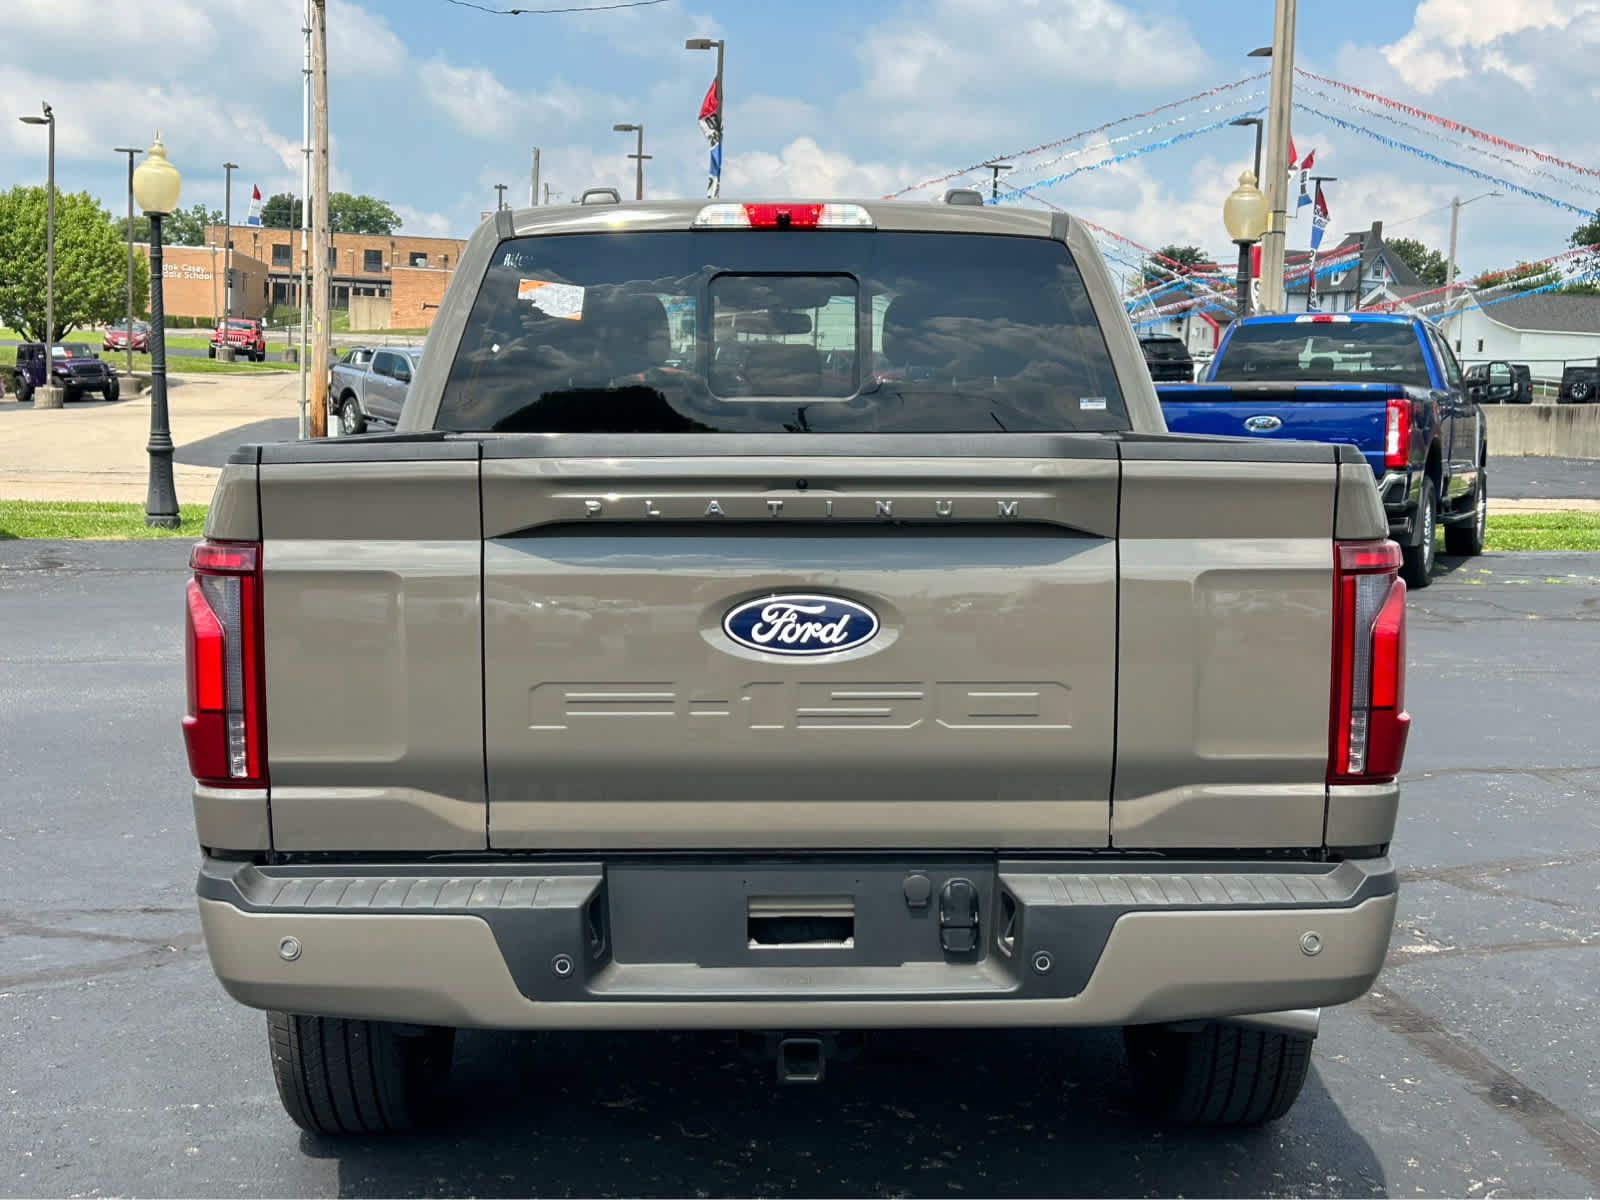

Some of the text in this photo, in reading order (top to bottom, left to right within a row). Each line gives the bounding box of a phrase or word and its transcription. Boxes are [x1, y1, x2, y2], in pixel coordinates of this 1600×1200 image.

[584, 500, 1018, 518] PLATINUM
[751, 602, 851, 644] Ford
[528, 681, 1074, 731] F-150
